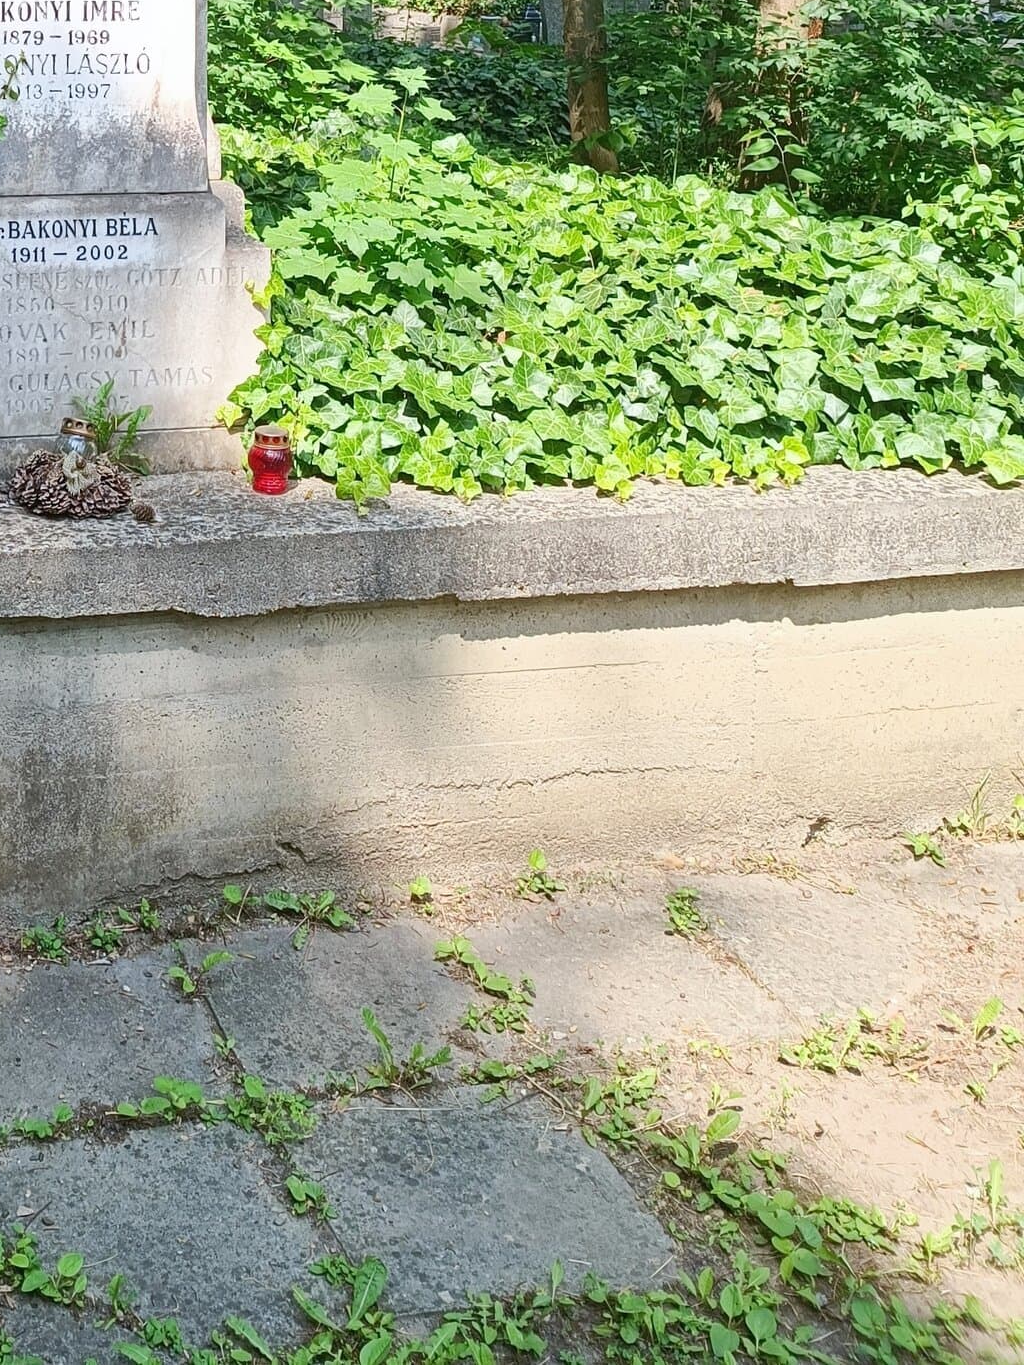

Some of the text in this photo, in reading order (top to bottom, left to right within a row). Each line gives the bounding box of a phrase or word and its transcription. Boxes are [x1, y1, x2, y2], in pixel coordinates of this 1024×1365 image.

[82, 0, 141, 23] IMRE
[3, 30, 44, 46] 1879
[67, 30, 110, 46] 1969
[65, 47, 151, 77] LÁSZLÓ
[68, 83, 113, 100] 1997
[106, 211, 159, 237] BÉLA
[12, 246, 46, 263] 1911
[76, 244, 129, 261] 2002
